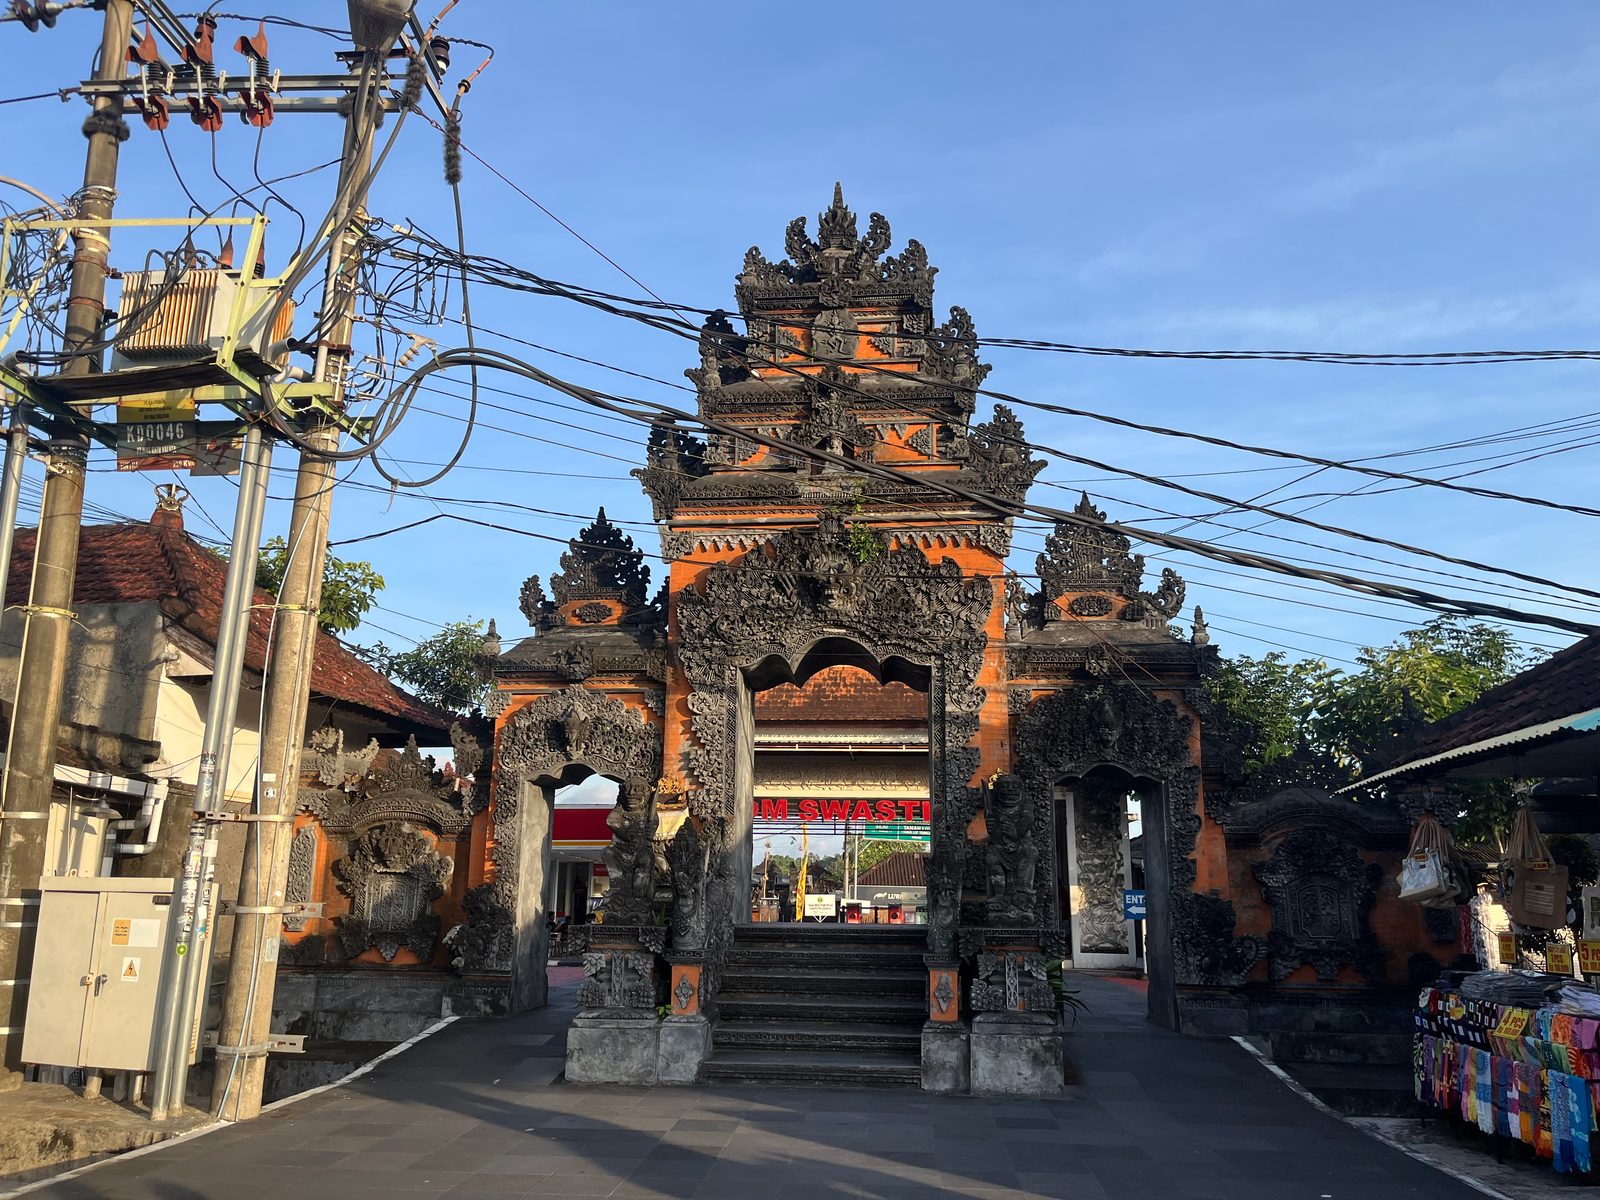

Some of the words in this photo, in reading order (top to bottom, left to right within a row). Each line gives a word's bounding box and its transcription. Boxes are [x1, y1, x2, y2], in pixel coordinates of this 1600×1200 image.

[753, 799, 788, 821] M
[1125, 894, 1146, 904] ENT
[1581, 943, 1589, 960] 5
[1503, 1011, 1512, 1025] 4
[1509, 1017, 1525, 1029] PCS
